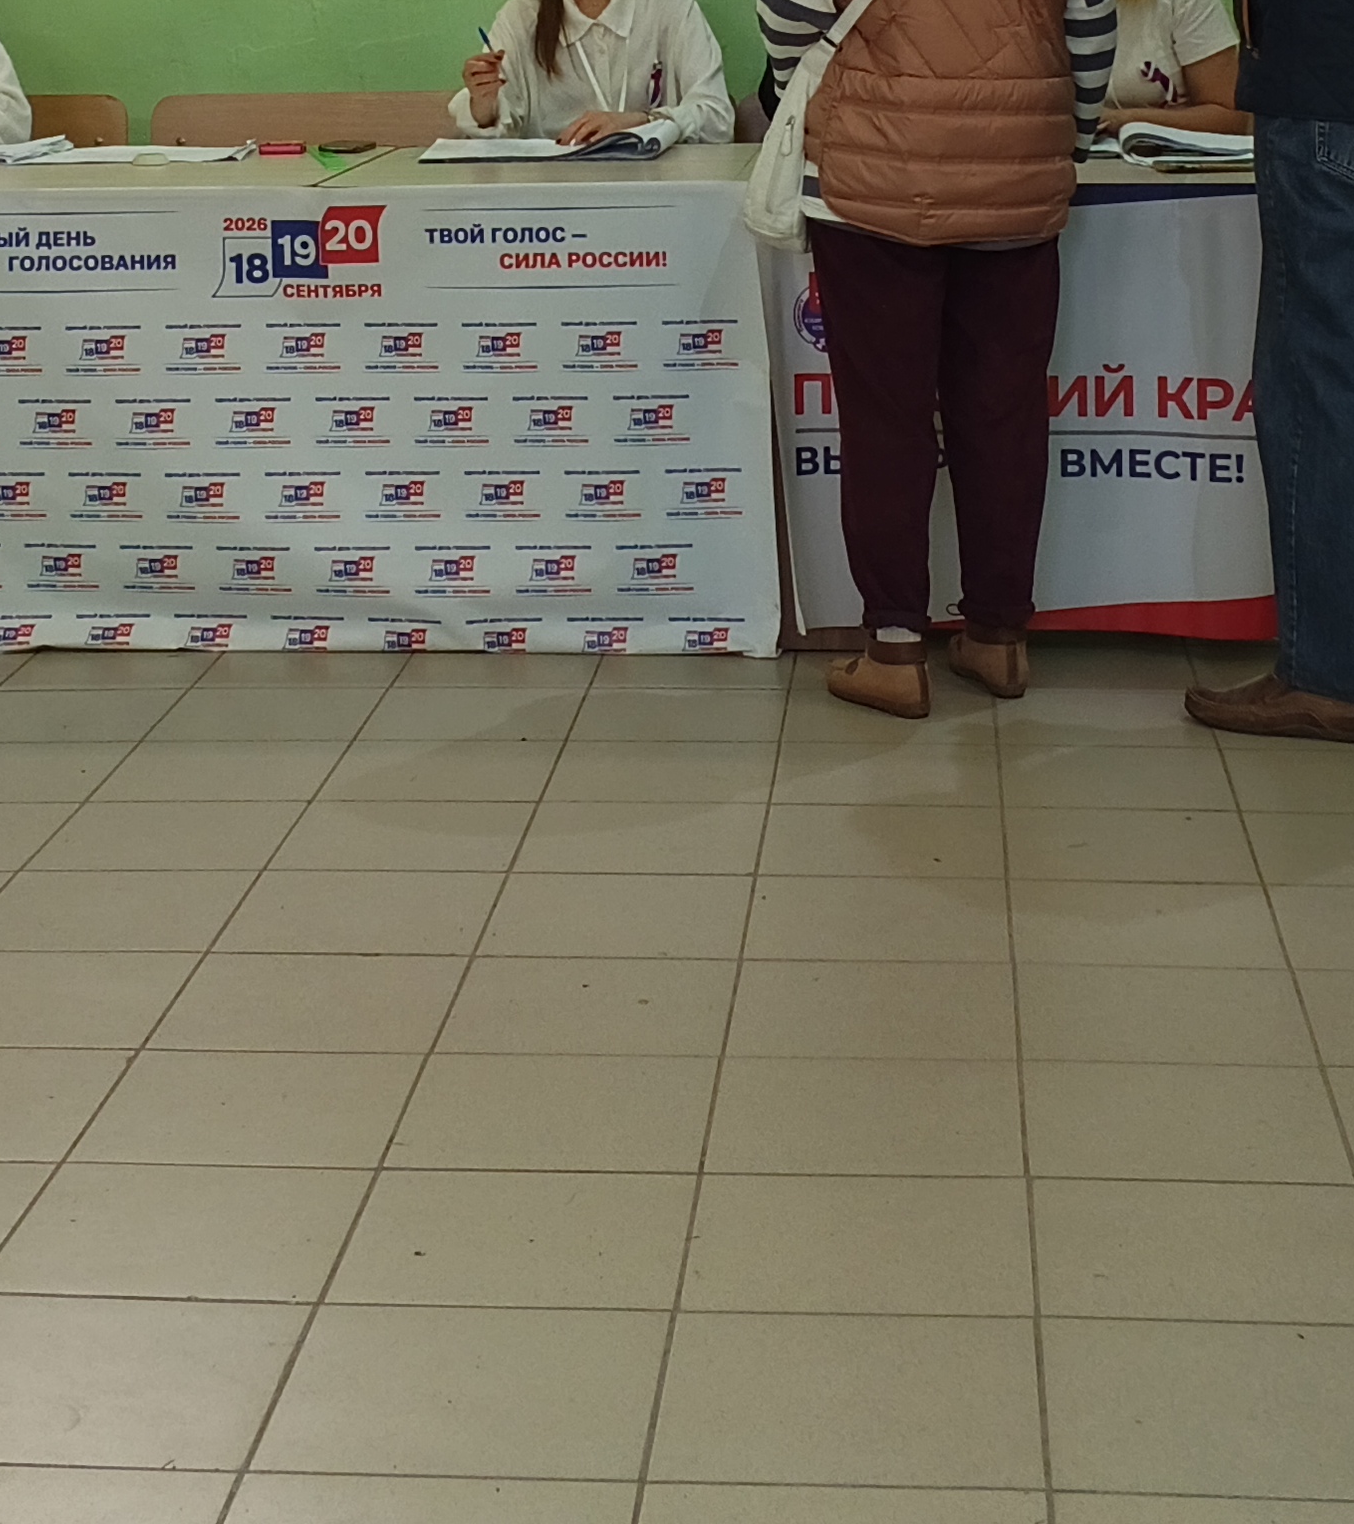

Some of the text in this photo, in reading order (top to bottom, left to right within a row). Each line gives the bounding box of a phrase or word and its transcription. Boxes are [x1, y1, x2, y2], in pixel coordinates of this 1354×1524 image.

[223, 217, 267, 232] 2026
[425, 224, 484, 244] ТВОЙ
[491, 227, 566, 244] ГОЛОС
[36, 230, 96, 250] ДЕНЬ
[229, 220, 373, 284] 18 19 20
[499, 251, 667, 269] СИЛА РОССИИ!
[8, 254, 176, 272] ГОЛОСОВАНИЯ
[282, 283, 382, 298] СЕНТЯБРЯ
[1061, 449, 1244, 483] ВМЕСТЕ!
